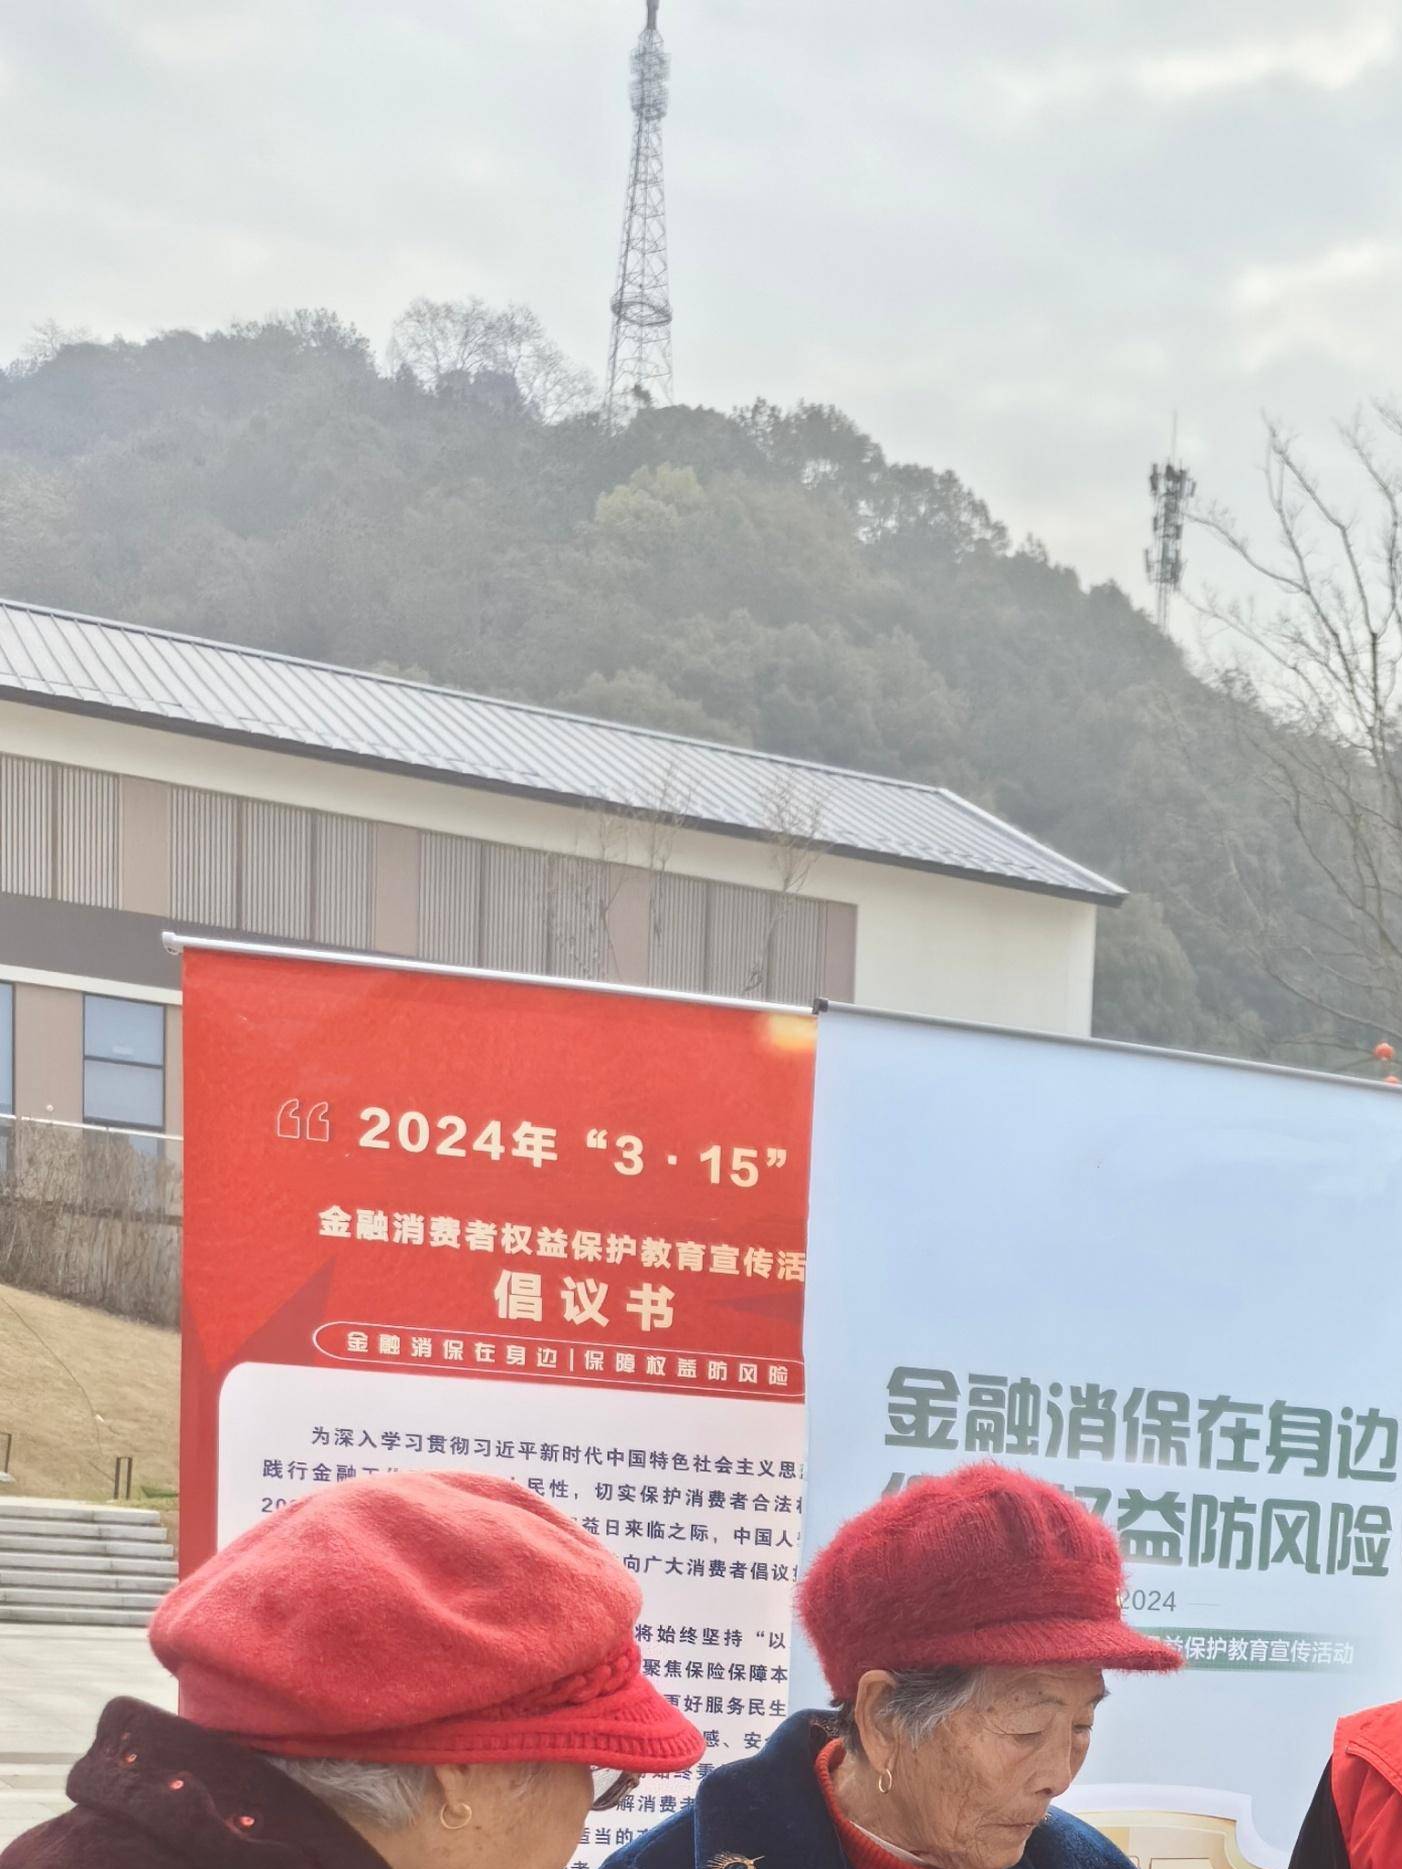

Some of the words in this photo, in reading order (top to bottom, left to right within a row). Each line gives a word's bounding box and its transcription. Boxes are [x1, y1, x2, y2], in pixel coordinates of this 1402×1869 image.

[318, 1205, 806, 1283] 金融消费者权益保护教育宣传活
[494, 1270, 675, 1331] 倡议书
[885, 1366, 1400, 1483] 金融消保在身边
[311, 1426, 804, 1480] 为深入学习贯彻习近平新时代中国特色社会主义思
[512, 1476, 802, 1514] 民性，切实保护消费者合法
[571, 1517, 800, 1548] 益日来临之际，中国人
[1118, 1589, 1176, 1612] 2024
[1147, 1635, 1354, 1665] 保护教育宣传活动
[642, 1658, 788, 1683] 聚焦保险保障本
[703, 1730, 771, 1750] 感、安
